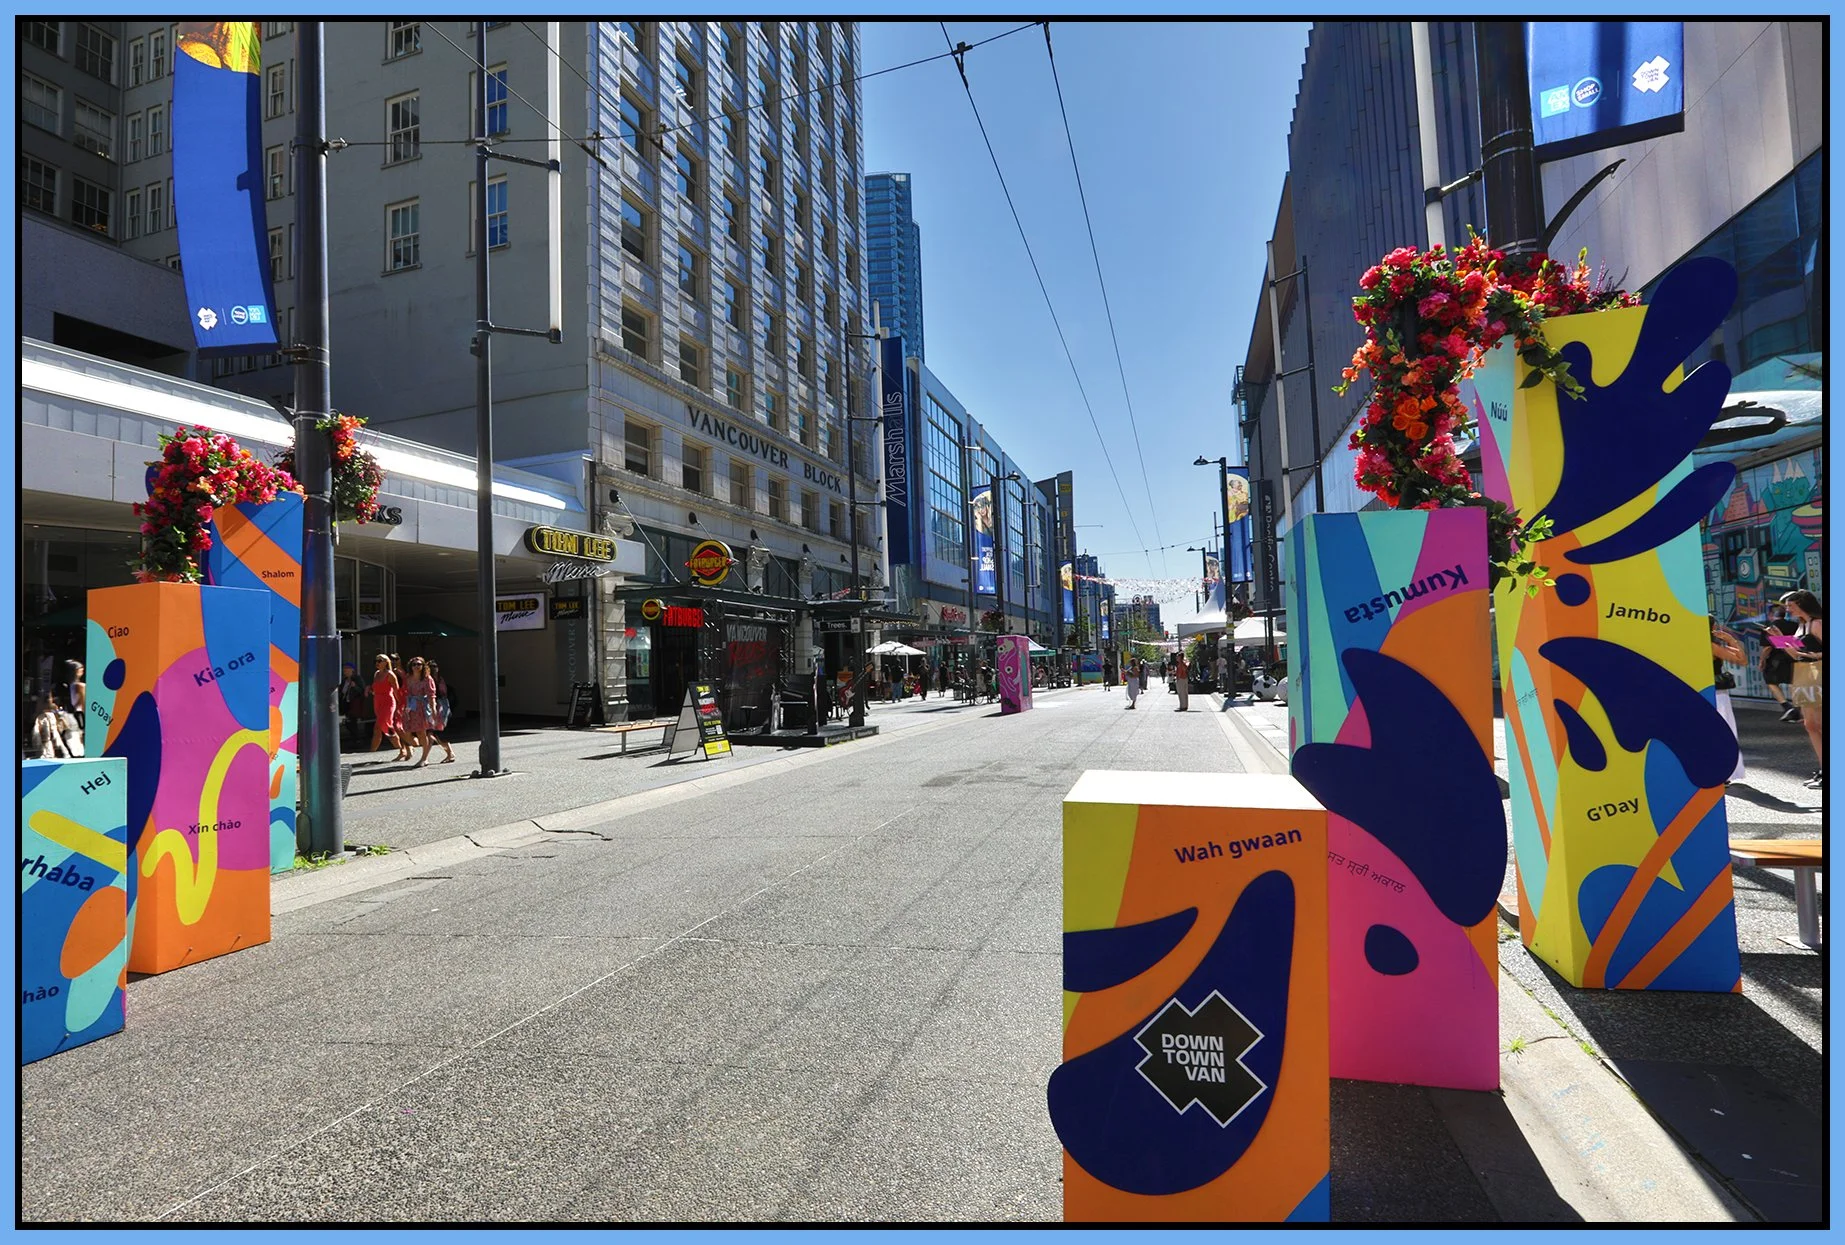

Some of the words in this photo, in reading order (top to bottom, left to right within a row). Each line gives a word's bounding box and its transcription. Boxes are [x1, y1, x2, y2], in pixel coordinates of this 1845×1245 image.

[1576, 83, 1596, 96] SHOP
[1490, 400, 1508, 422] Núú
[687, 405, 789, 469] VANCOUVER
[803, 462, 842, 494] BLOCK
[883, 391, 907, 507] Marshalls
[542, 529, 579, 554] TOM
[583, 537, 612, 560] LEE
[261, 570, 295, 579] Shalom
[1343, 564, 1469, 623] Kumusta
[497, 602, 516, 611] TOM
[519, 600, 536, 610] LEE
[1605, 602, 1671, 624] Jambo
[107, 626, 130, 639] Ciao
[726, 624, 768, 642] VANCOUVER
[193, 667, 225, 687] Kia
[227, 652, 255, 671] ora
[90, 701, 114, 727] G'Day
[80, 771, 112, 795] Hej
[1586, 797, 1639, 822] G'Day
[188, 822, 209, 835] Xin
[1174, 841, 1224, 864] Wah
[1228, 829, 1303, 859] gwaan
[1161, 1033, 1224, 1052] DOWN
[1162, 1049, 1225, 1068] TOWN
[1184, 1065, 1226, 1083] VAN
